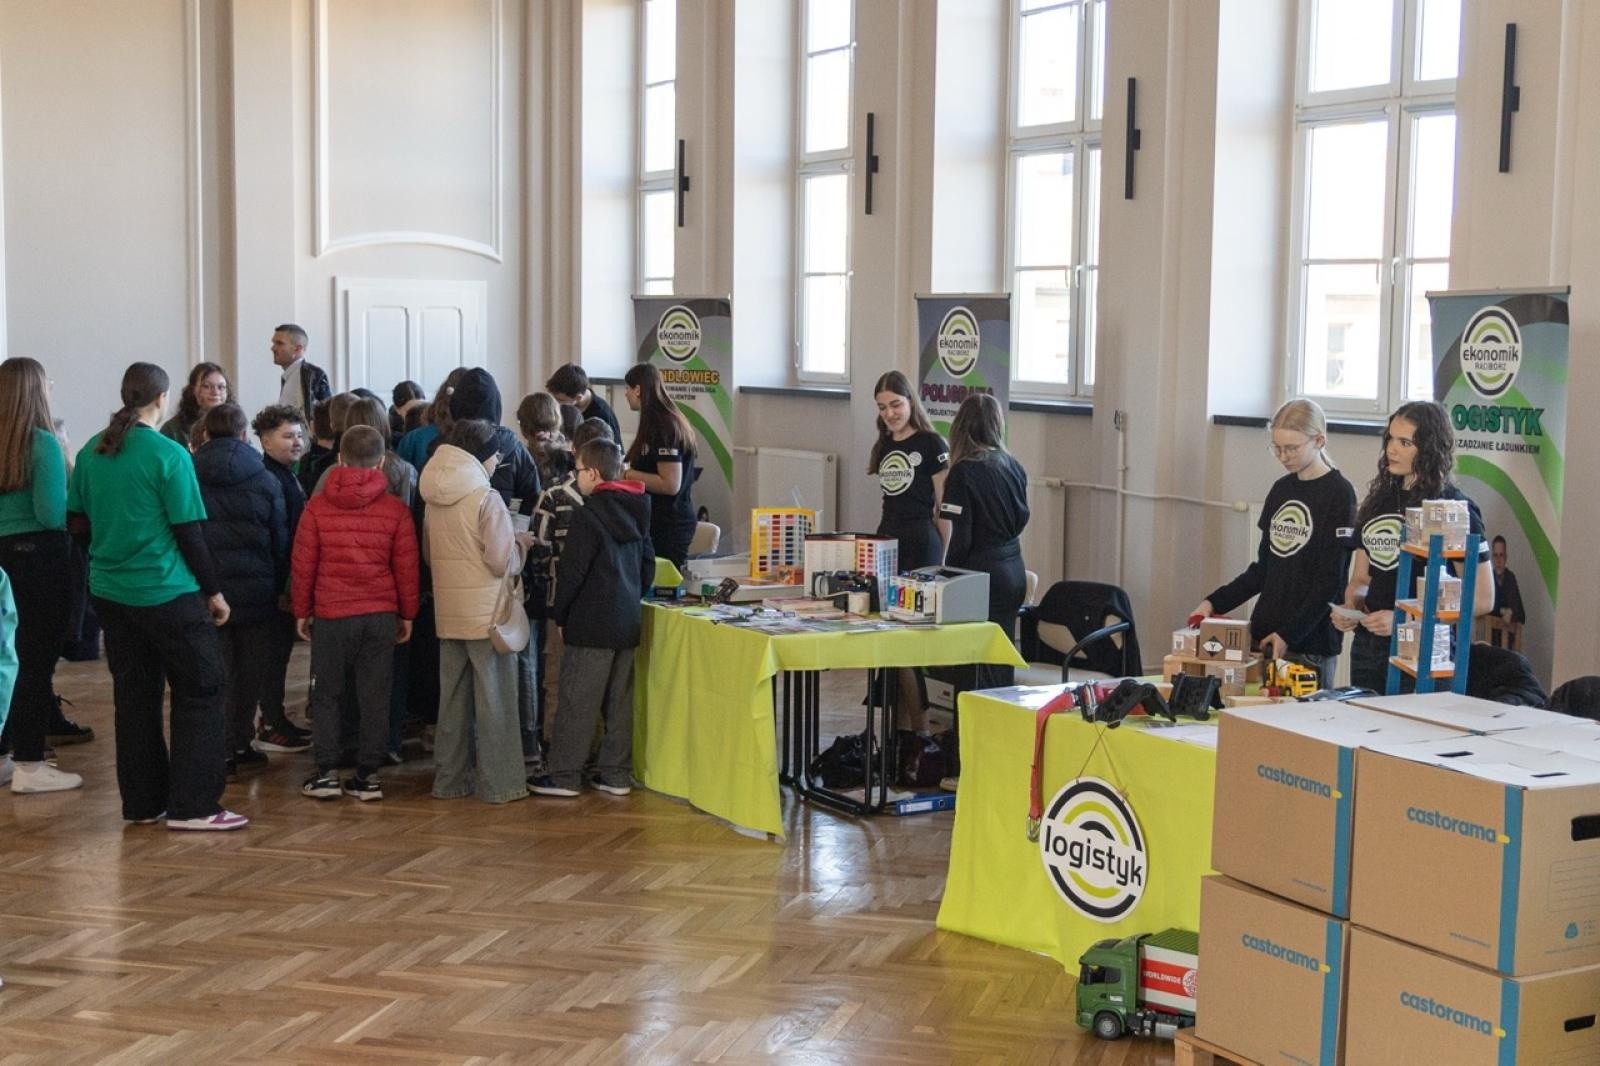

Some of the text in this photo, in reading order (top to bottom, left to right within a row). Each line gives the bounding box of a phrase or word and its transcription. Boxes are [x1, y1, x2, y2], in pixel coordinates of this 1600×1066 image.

[659, 330, 699, 341] ekonomik
[940, 337, 978, 350] ekonomik
[1463, 346, 1519, 361] ekonomik
[659, 369, 720, 384] NDLOWIEC
[1451, 404, 1545, 436] OGISTYK
[1257, 764, 1331, 798] castorama
[1407, 807, 1496, 843] castorama
[1045, 825, 1142, 887] logistyk
[1242, 934, 1319, 971] castorama
[1400, 991, 1493, 1036] castorama
